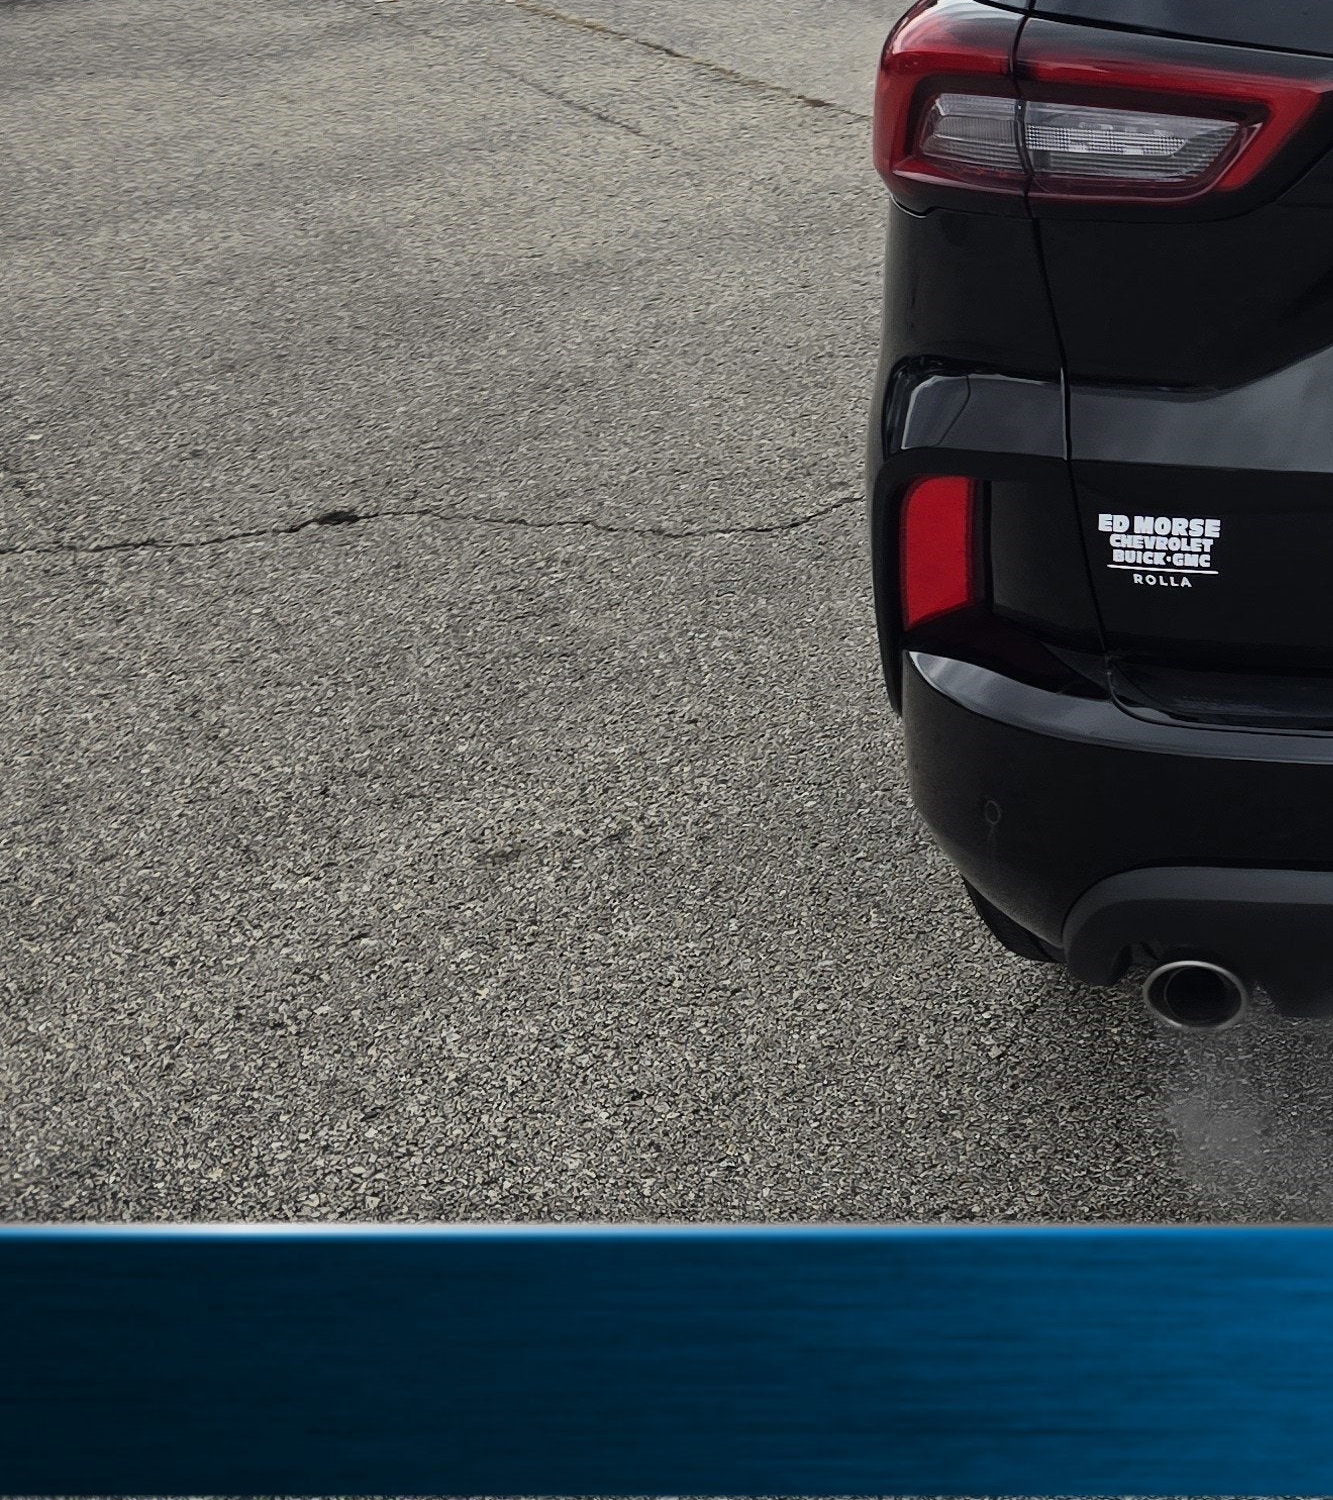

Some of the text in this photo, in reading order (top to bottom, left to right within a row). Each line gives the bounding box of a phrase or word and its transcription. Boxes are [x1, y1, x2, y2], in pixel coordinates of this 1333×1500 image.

[1098, 513, 1221, 538] ED MORSE
[1109, 533, 1214, 552] CHEVROLET
[1132, 573, 1193, 588] ROLLA
